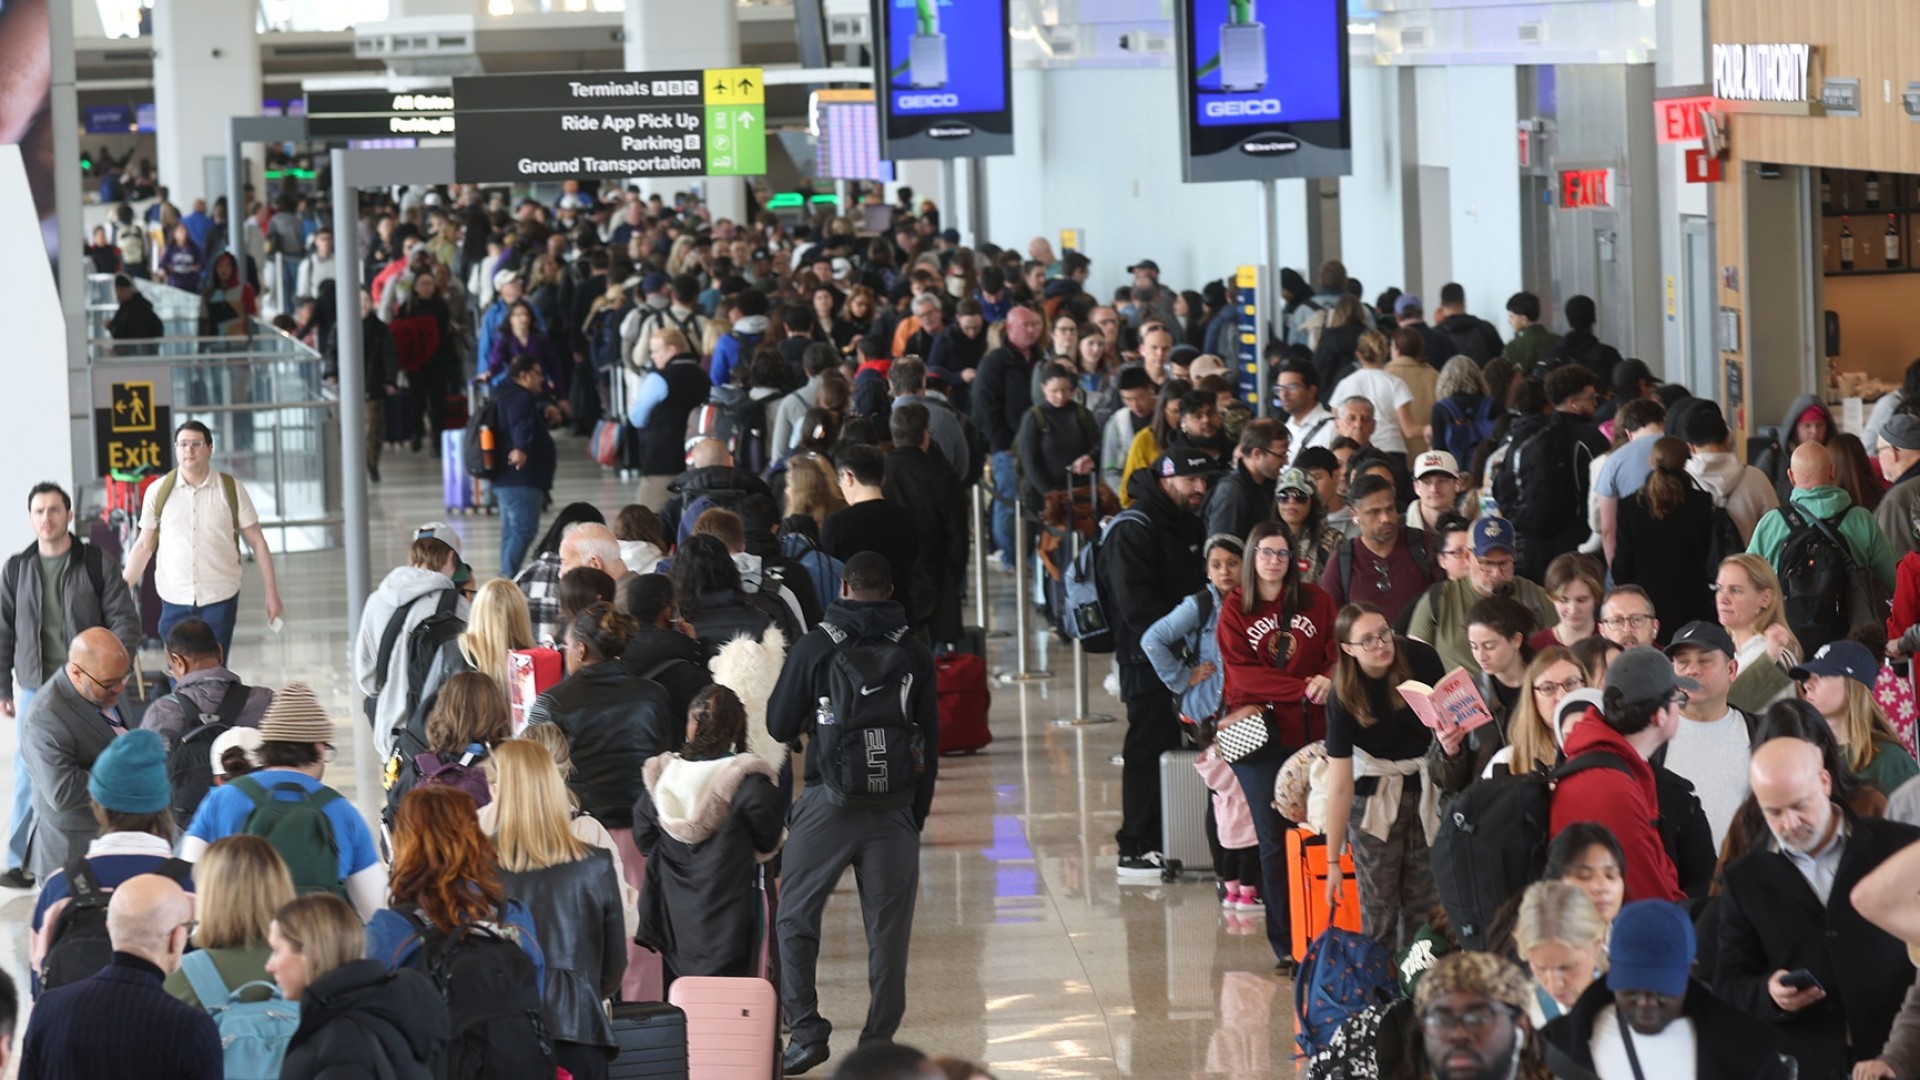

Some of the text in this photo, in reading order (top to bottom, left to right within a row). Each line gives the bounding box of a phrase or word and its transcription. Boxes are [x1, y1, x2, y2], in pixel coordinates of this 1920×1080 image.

[1713, 44, 1809, 101] POUR AUTHORITY
[569, 82, 649, 97] Terminals
[898, 94, 958, 109] GEICO
[1206, 99, 1281, 117] GEICO
[561, 113, 699, 132] Ride App Pick Up
[621, 136, 683, 153] Parking
[518, 156, 701, 174] Ground Transportation
[1563, 169, 1608, 206] EXIT
[109, 440, 161, 468] Exit
[1443, 680, 1460, 694] RED
